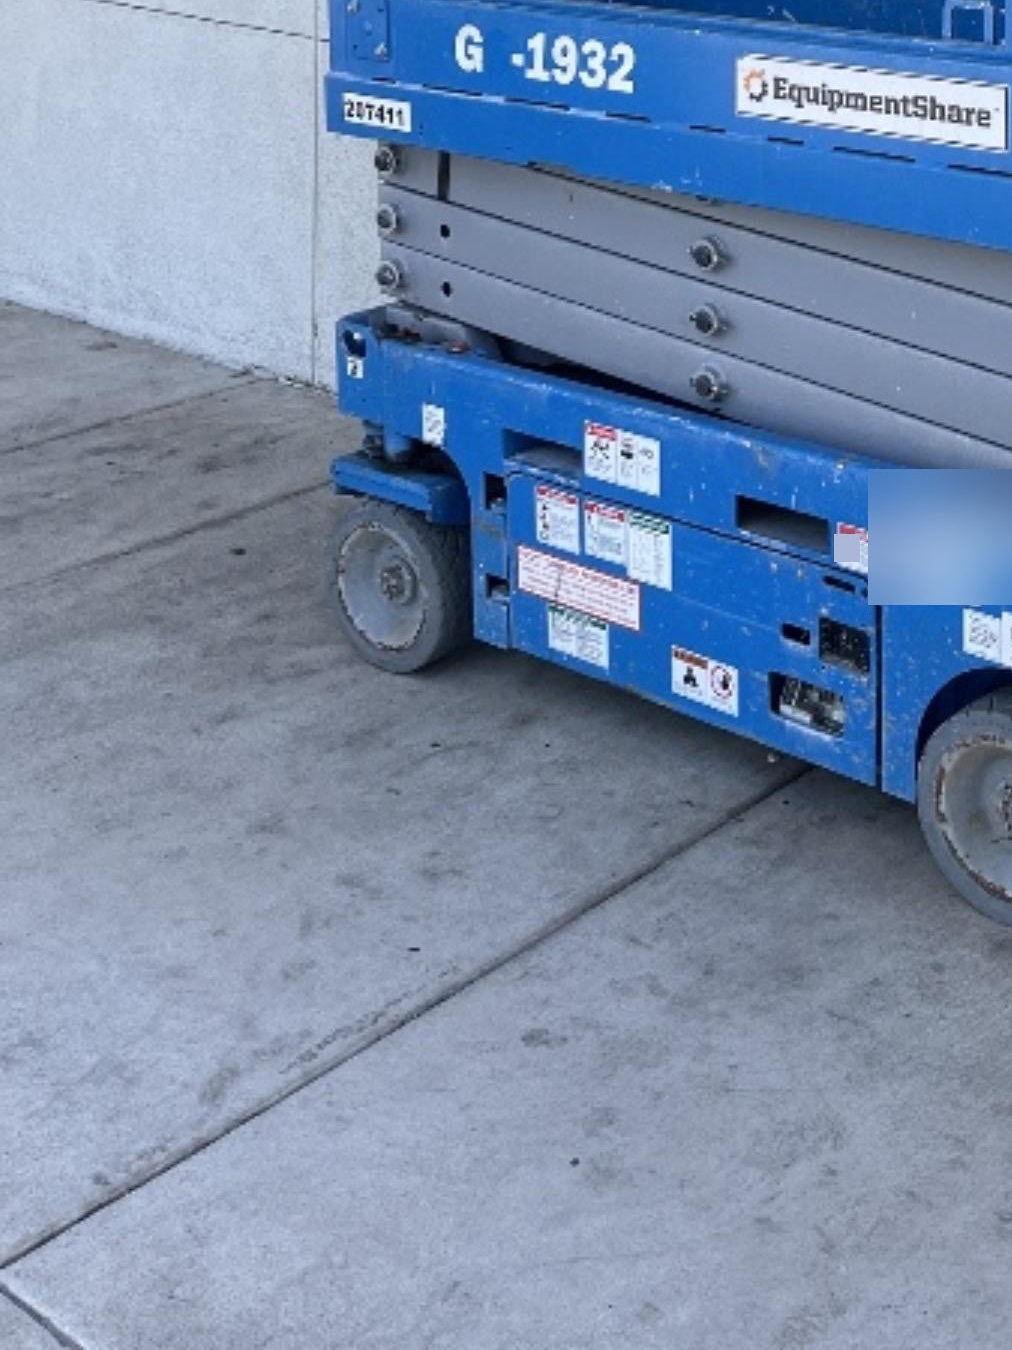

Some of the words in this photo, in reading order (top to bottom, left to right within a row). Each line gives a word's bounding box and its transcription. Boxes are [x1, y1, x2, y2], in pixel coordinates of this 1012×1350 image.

[455, 23, 484, 73] G
[511, 32, 636, 94] -1932
[773, 77, 991, 128] EquipmentShare
